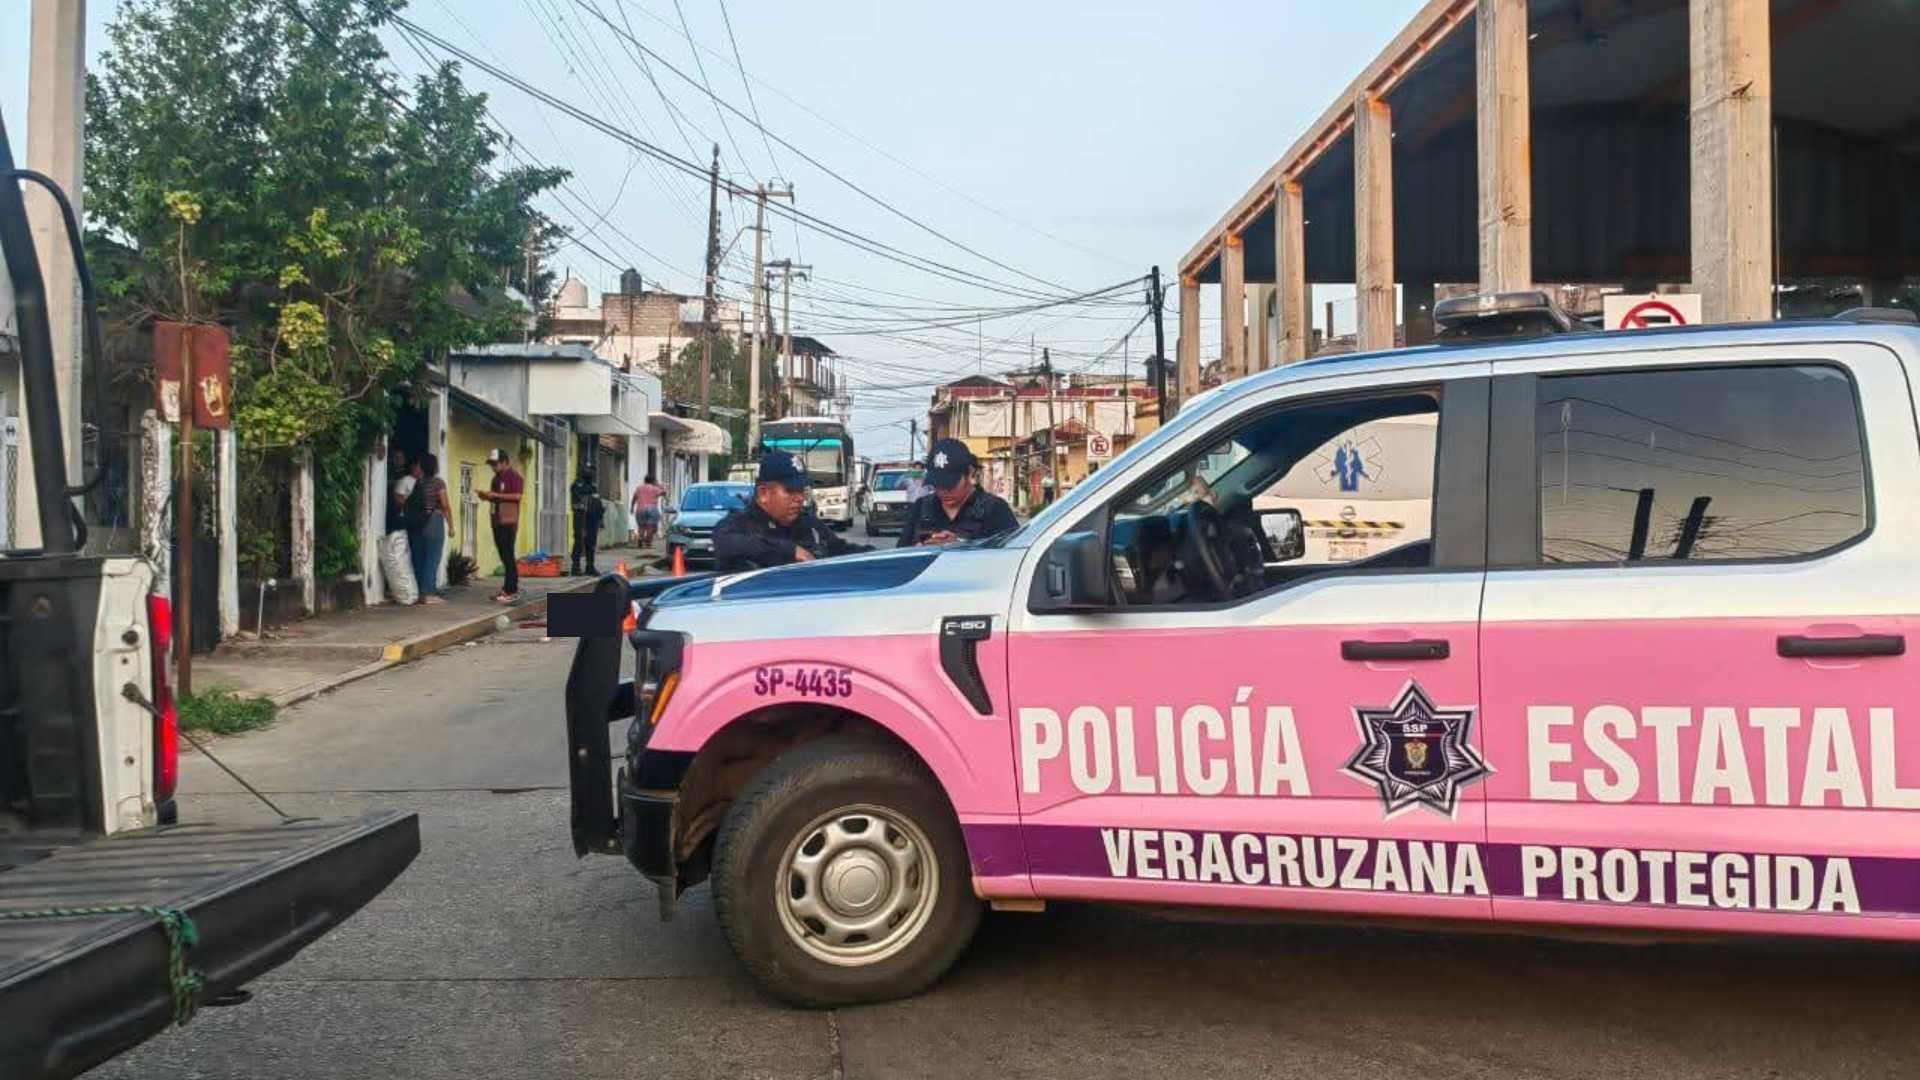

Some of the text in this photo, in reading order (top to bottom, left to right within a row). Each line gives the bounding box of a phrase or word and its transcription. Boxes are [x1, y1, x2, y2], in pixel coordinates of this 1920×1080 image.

[754, 666, 853, 698] SP-4435
[1018, 685, 1920, 809] POLICÍA ESTATAL
[1402, 723, 1429, 734] SSP
[1100, 827, 1861, 914] VERACRUZANA PROTEGIDA
